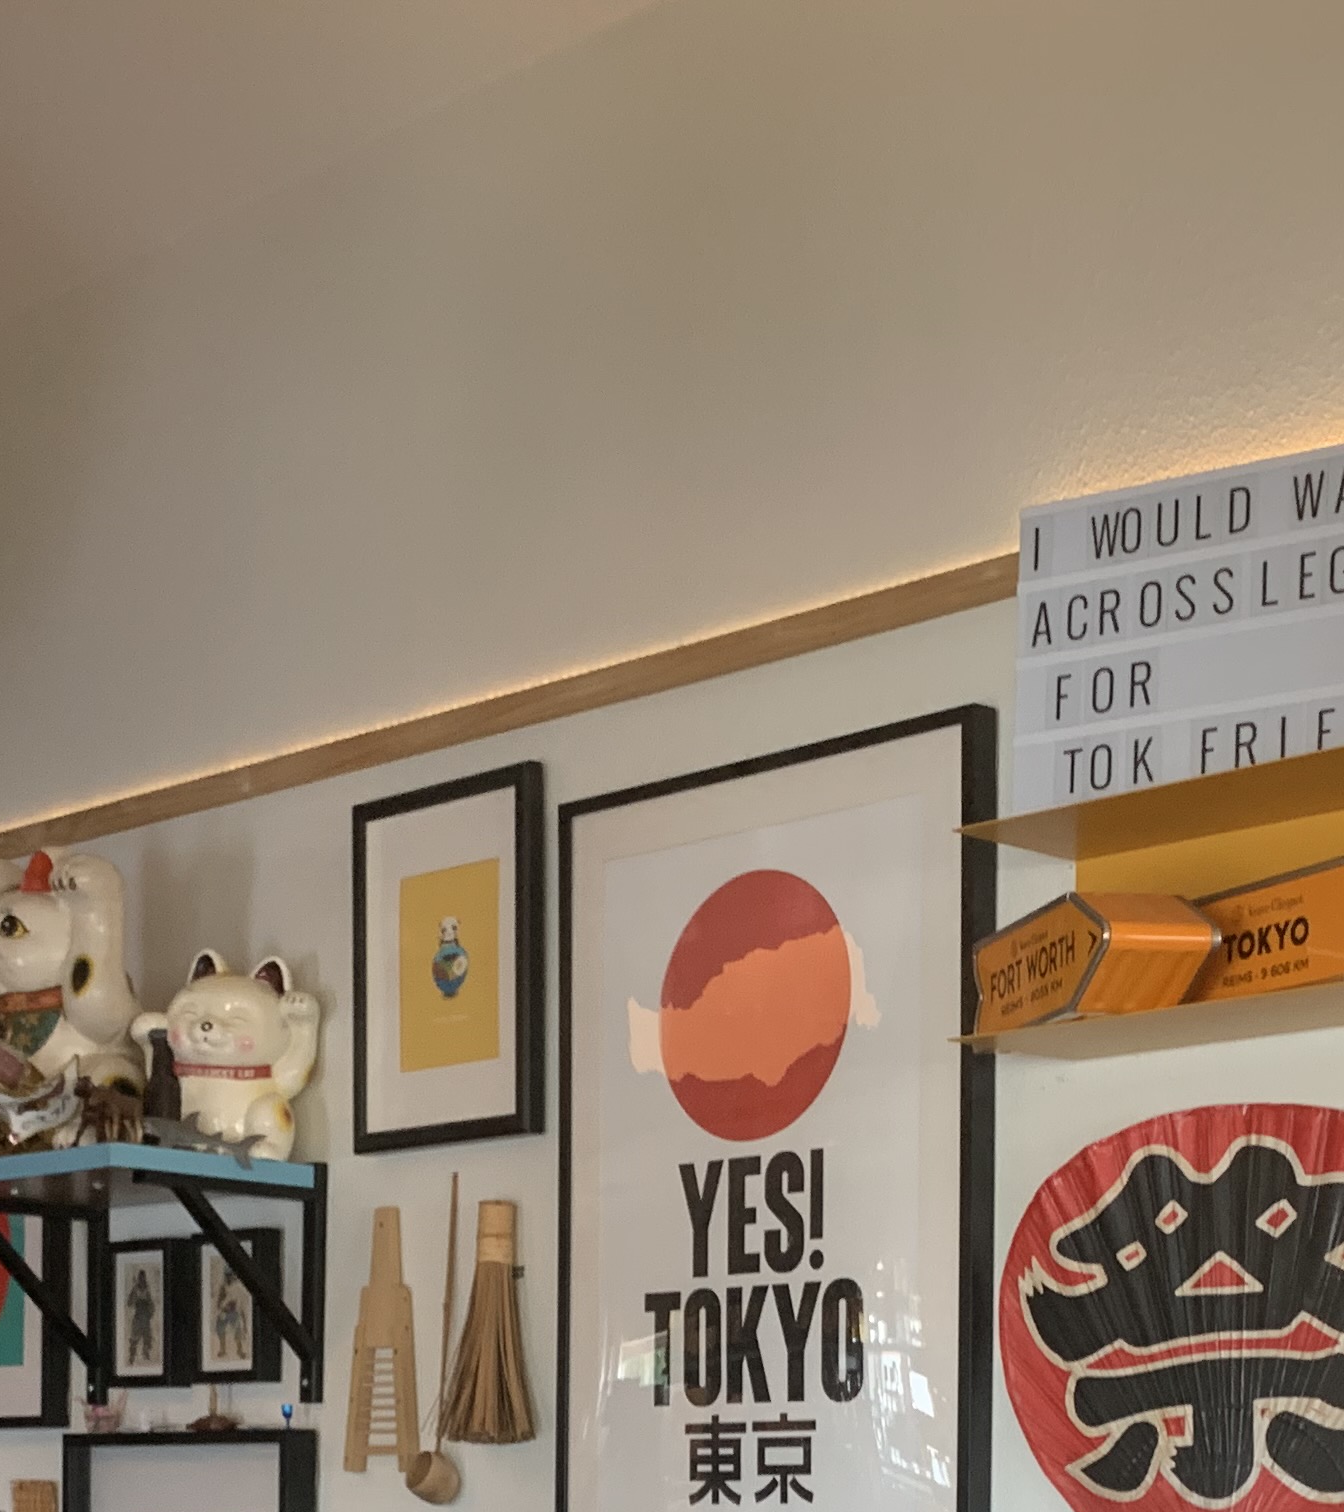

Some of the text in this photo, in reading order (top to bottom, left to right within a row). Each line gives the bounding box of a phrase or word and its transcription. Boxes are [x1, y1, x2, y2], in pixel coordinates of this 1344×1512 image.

[1031, 527, 1042, 571] I
[1091, 486, 1253, 560] WOULD
[1031, 568, 1235, 648] ACROSS
[1055, 661, 1154, 721] FOR
[1063, 737, 1155, 794] TOK
[990, 959, 1023, 1004] FORT
[1026, 930, 1075, 983] WORTH
[1223, 916, 1309, 964] TOKYO
[678, 1148, 824, 1278] YES!
[644, 1277, 864, 1407] TOKYO
[685, 1413, 816, 1505] 東京
